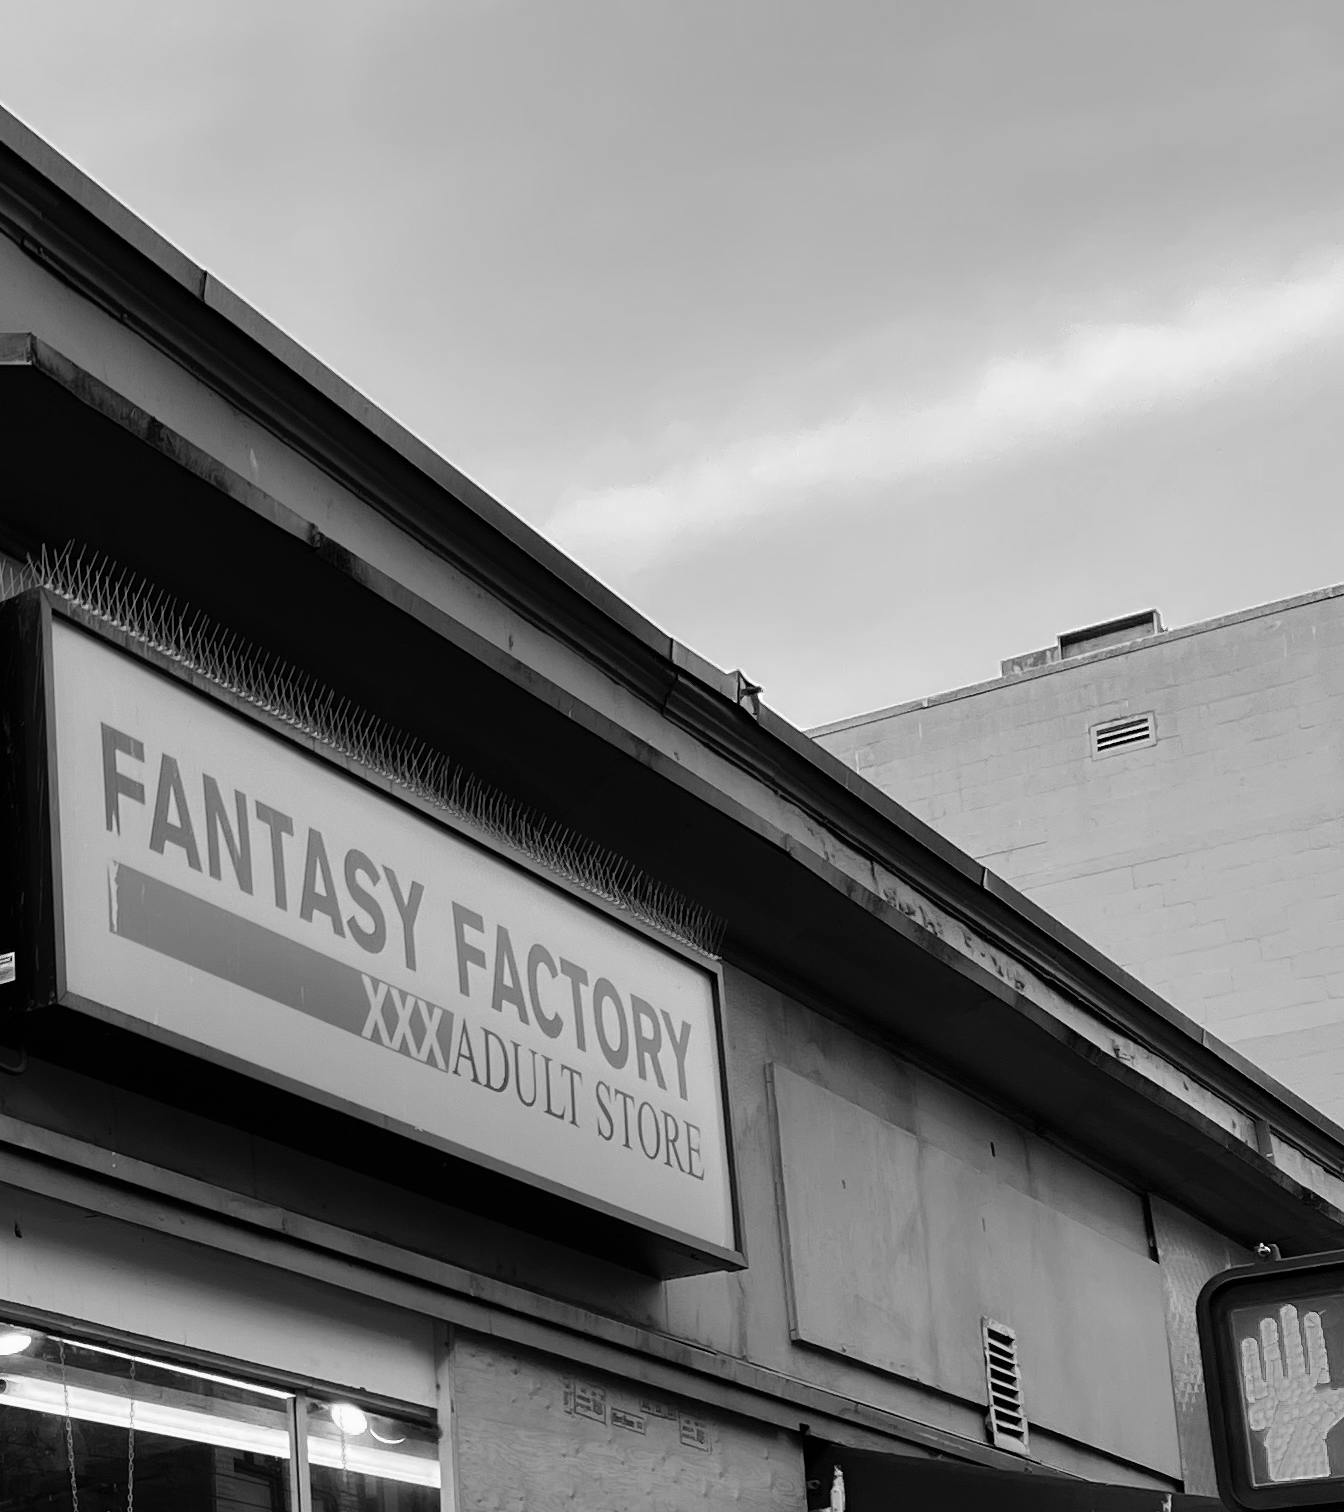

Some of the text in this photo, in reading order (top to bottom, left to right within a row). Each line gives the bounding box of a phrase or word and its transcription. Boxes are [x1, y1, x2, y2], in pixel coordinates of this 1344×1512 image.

[100, 721, 692, 1102] FANTASY FACTORY
[450, 1016, 583, 1127] ADULT
[596, 1084, 707, 1182] STORE
